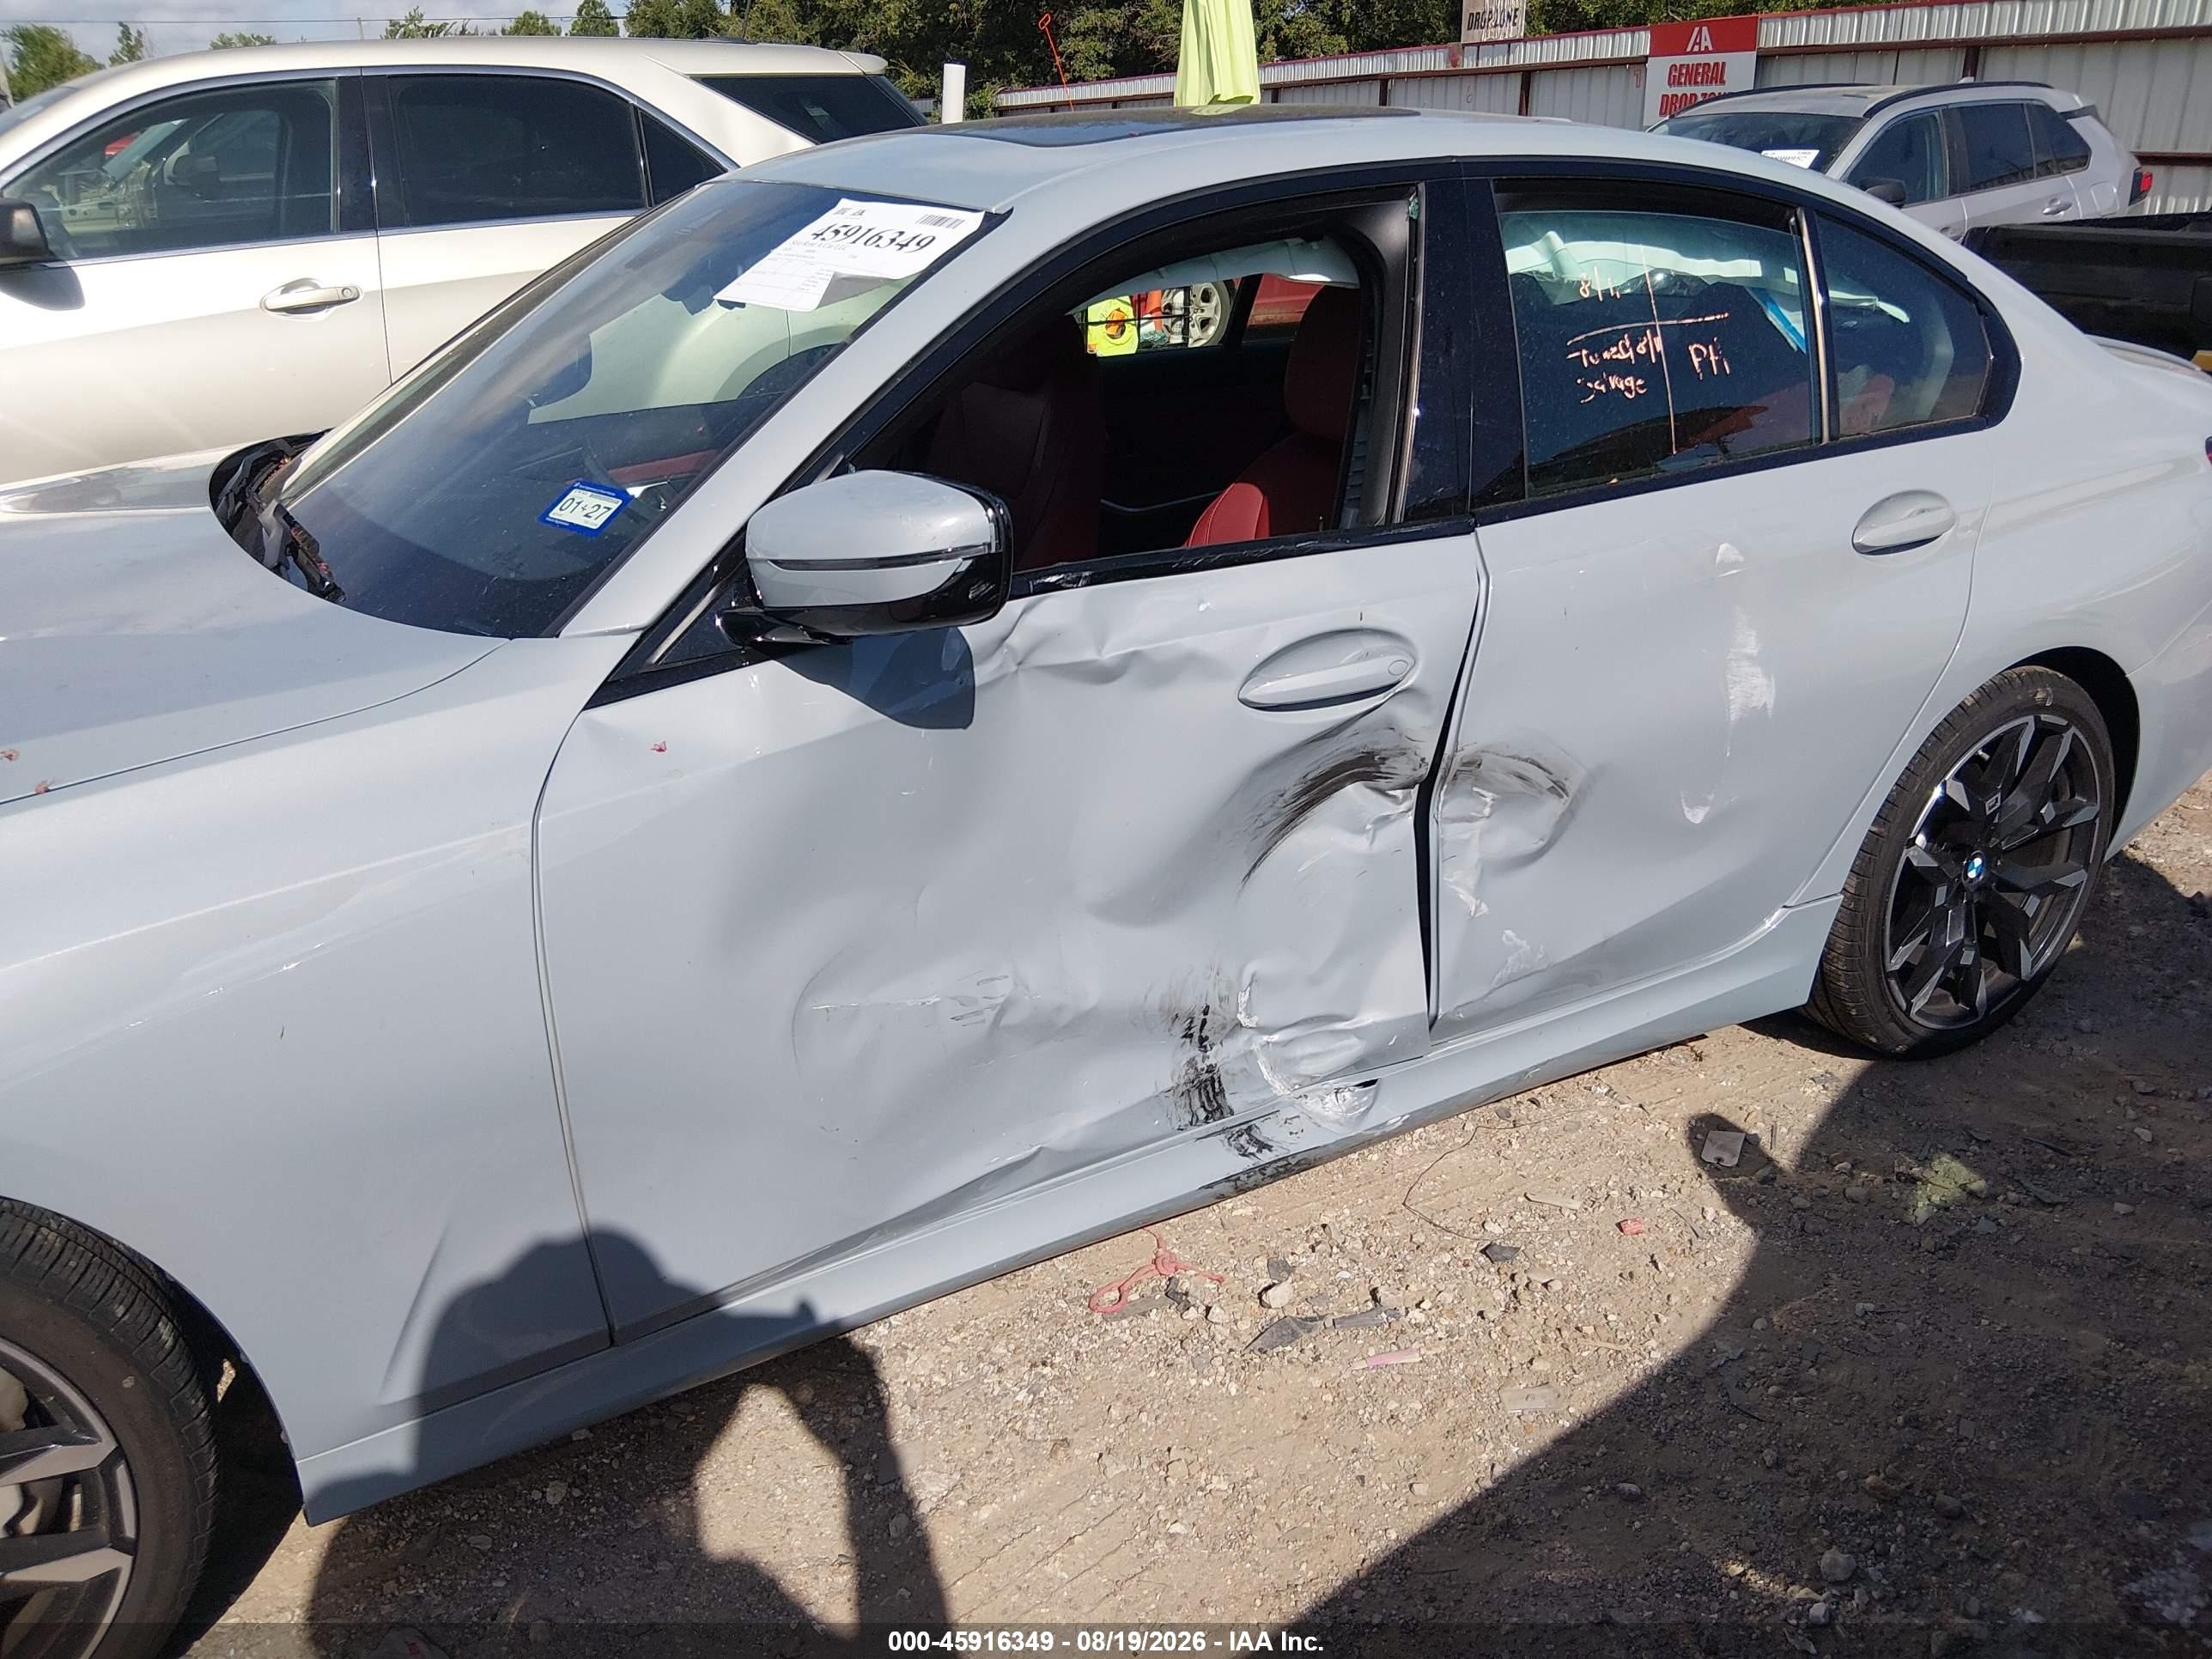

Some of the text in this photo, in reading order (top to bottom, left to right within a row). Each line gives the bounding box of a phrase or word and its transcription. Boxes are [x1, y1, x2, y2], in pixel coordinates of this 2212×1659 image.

[1467, 8, 1520, 31] DROP ZONE
[1667, 61, 1727, 88] GENERAL
[811, 223, 936, 253] 45916349
[559, 497, 613, 520] 01 27
